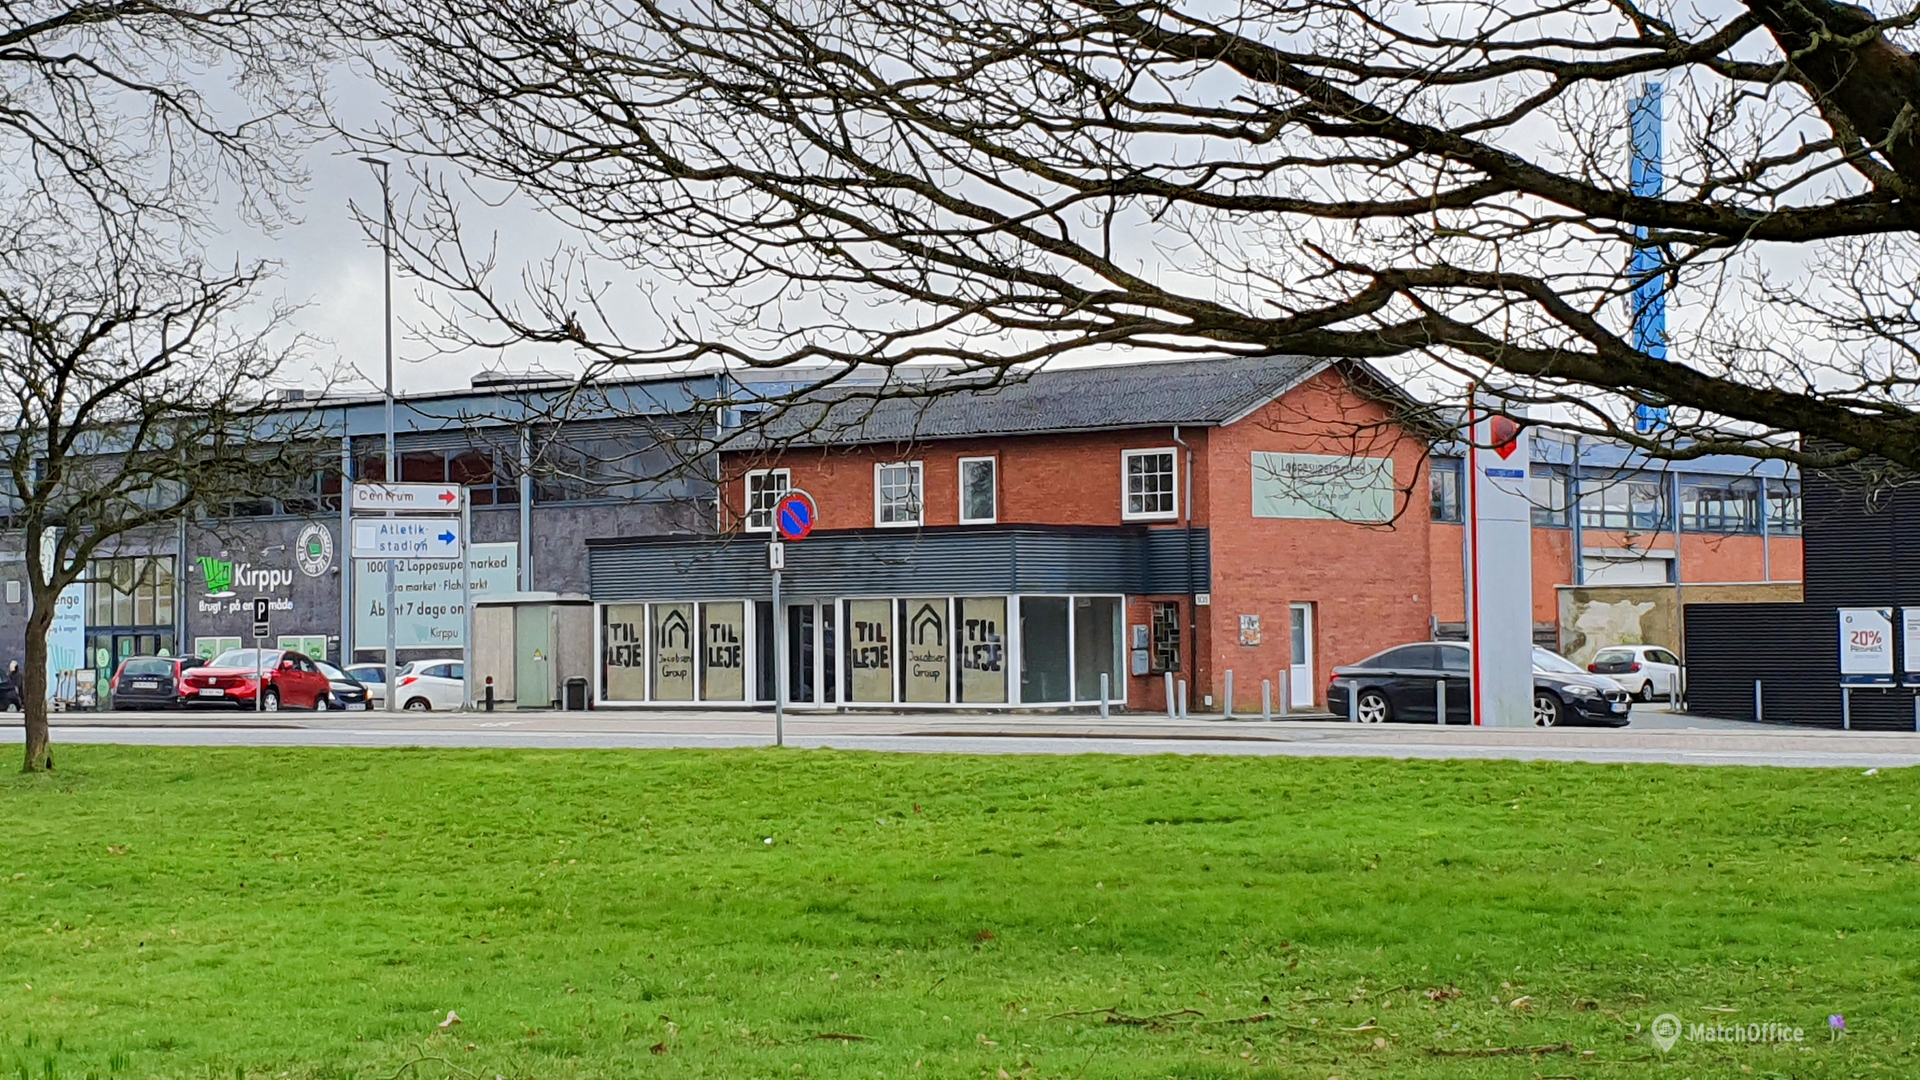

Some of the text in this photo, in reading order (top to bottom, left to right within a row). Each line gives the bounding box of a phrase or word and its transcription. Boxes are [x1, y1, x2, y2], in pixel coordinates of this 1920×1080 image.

[359, 489, 414, 501] Centrum
[380, 540, 429, 551] stadion
[234, 563, 293, 592] Kirppu
[199, 600, 221, 614] Brugt
[229, 599, 240, 614] på
[258, 601, 266, 620] P
[370, 599, 404, 616] Åbnt
[407, 602, 414, 615] 7
[417, 601, 446, 619] dage
[430, 627, 459, 641] Kirppu
[609, 623, 639, 643] TIL
[709, 623, 738, 643] TIL
[855, 621, 887, 642] TIL
[965, 619, 1000, 642] TIL
[1850, 631, 1882, 646] 20%
[608, 644, 641, 668] LEJE
[708, 645, 741, 668] LEJE
[853, 645, 889, 669] LEJE
[964, 644, 1001, 672] LEJE
[662, 665, 687, 680] Group
[913, 664, 940, 683] Group
